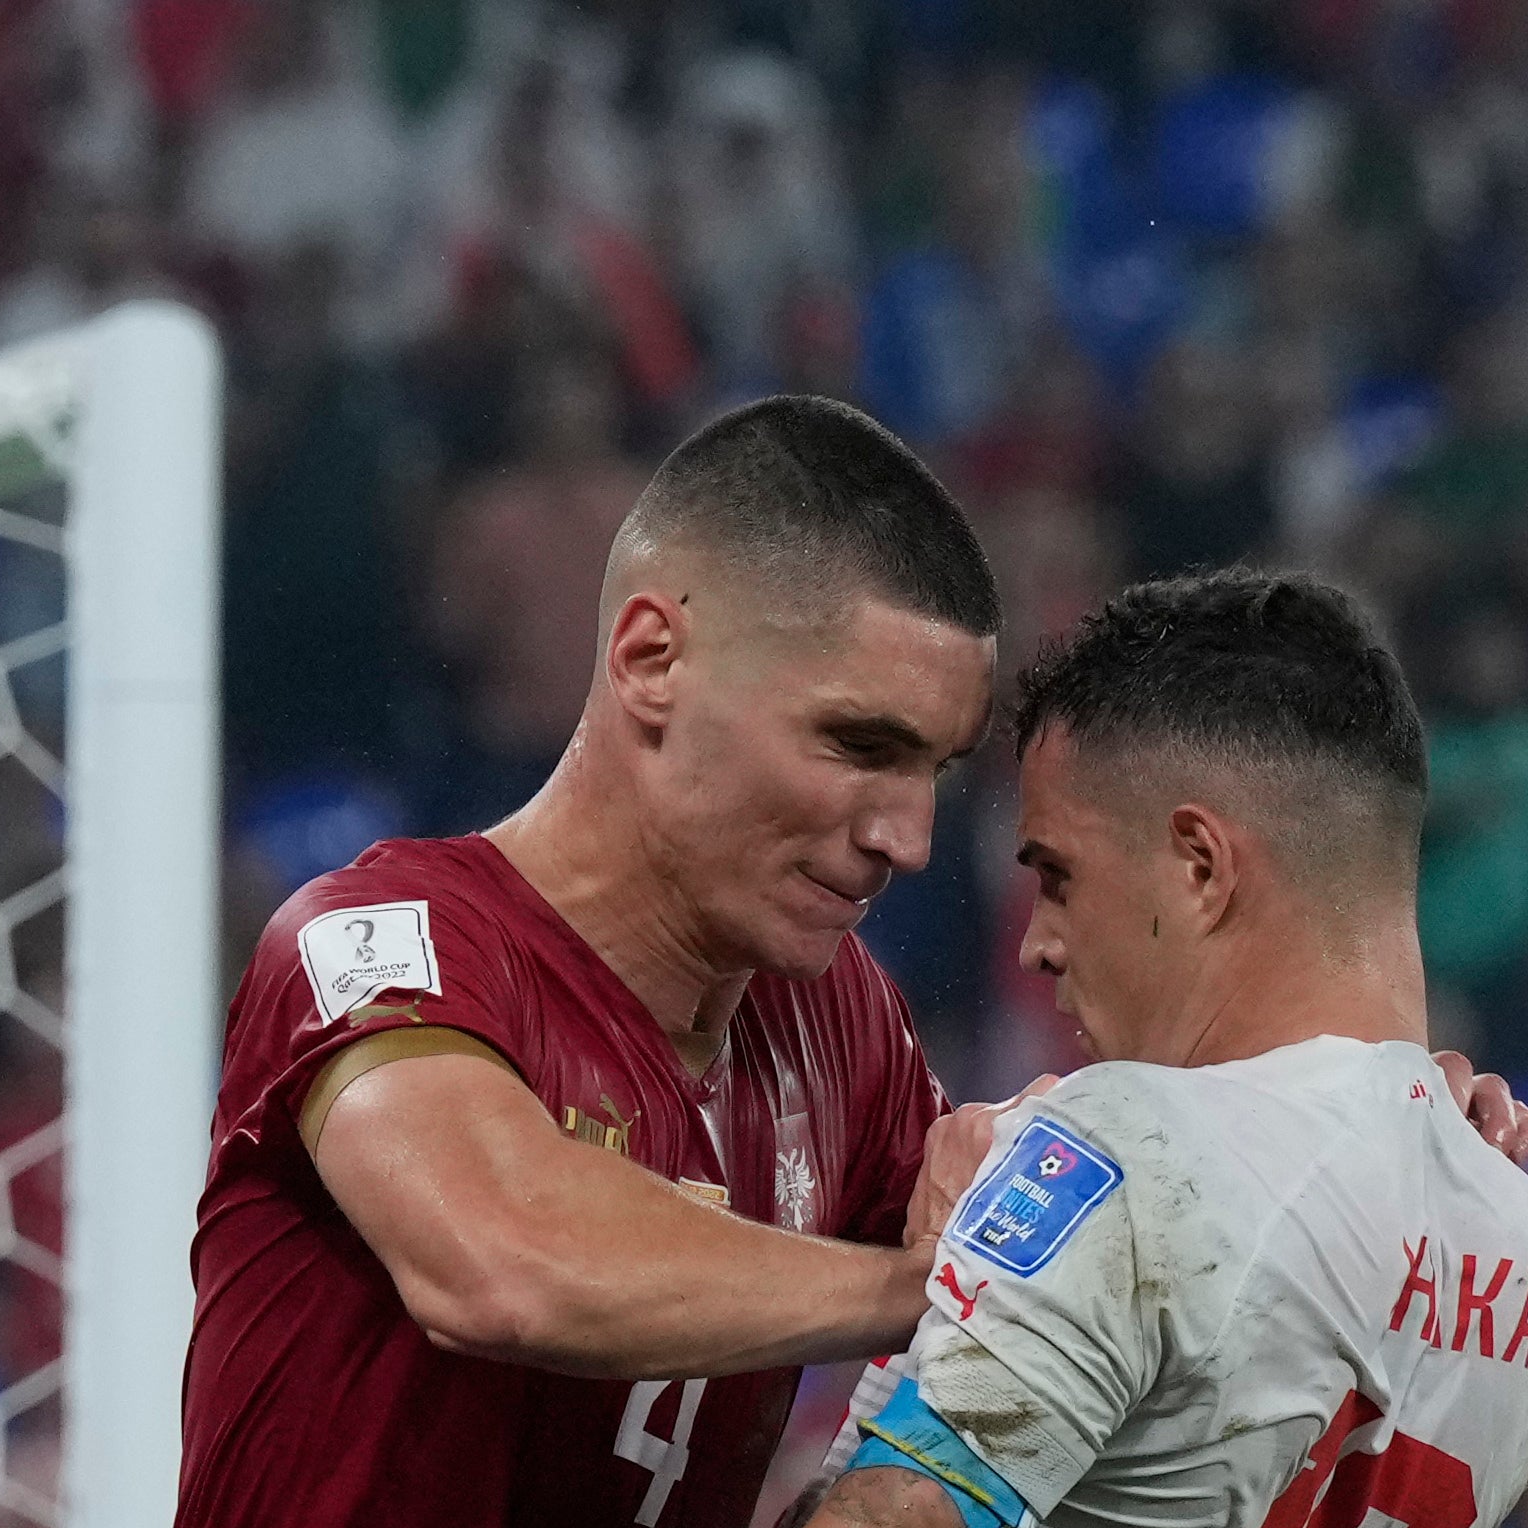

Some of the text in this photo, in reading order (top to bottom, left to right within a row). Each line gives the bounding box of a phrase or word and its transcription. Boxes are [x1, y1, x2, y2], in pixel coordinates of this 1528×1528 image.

[331, 962, 411, 990] FIFA WORLD CUP
[1009, 1173, 1055, 1208] FOOTBALL
[613, 1378, 708, 1528] 4
